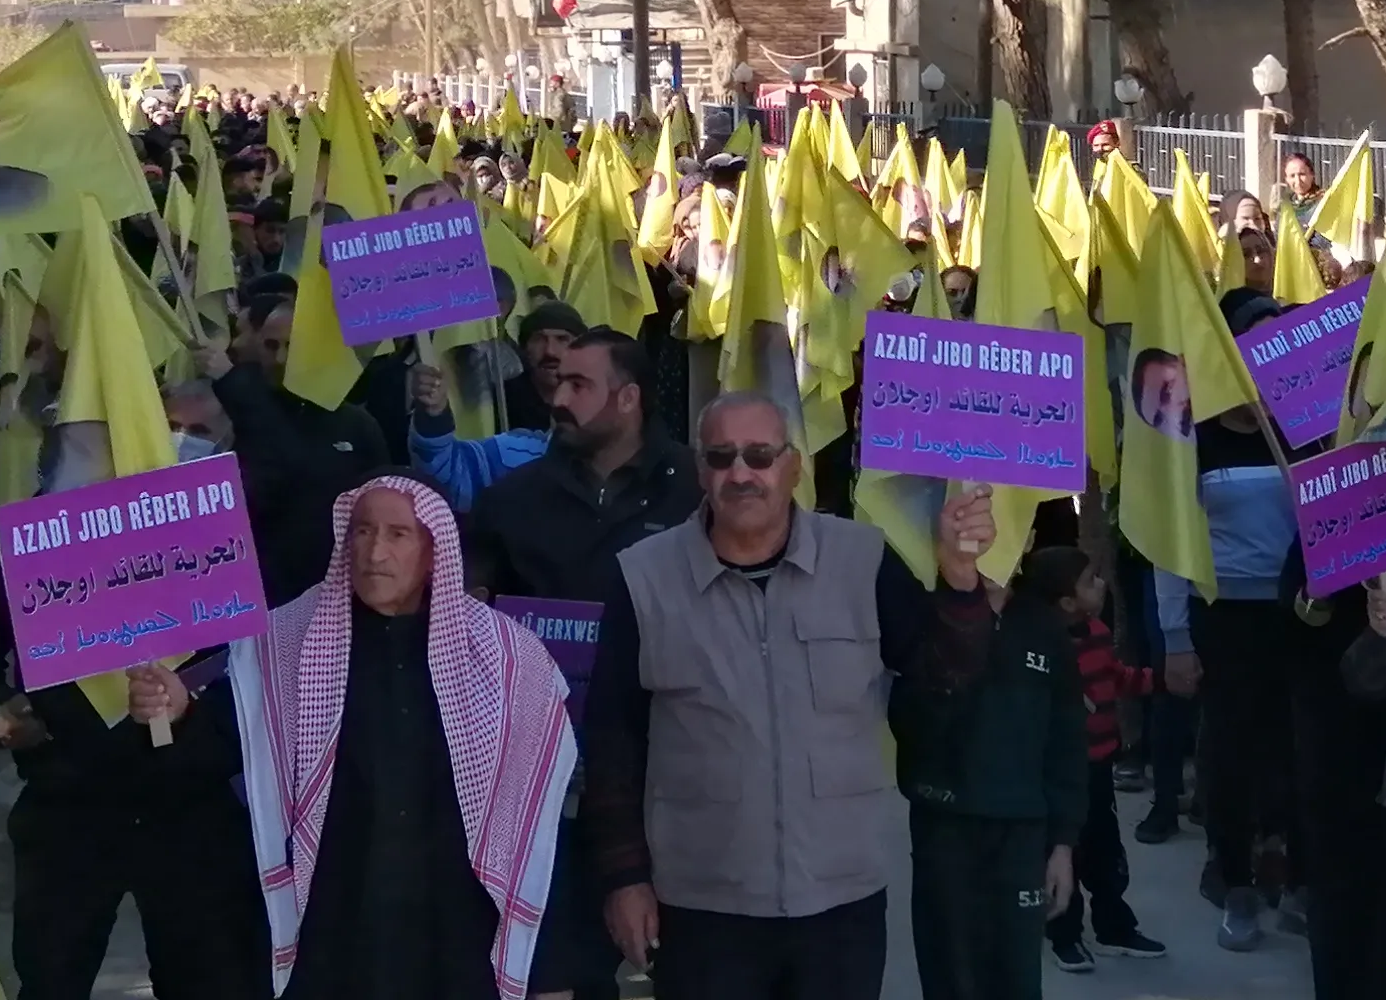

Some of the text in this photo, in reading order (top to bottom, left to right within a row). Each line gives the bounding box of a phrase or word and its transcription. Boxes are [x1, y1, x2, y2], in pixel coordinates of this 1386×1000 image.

[331, 216, 473, 262] AZADÎ JIBO RÊBER APO
[873, 332, 1073, 380] AZADÎ JIBO RÊBER APO
[1250, 301, 1362, 367] AZADÎ JIBO RÊBER
[872, 380, 1076, 427] الحرية للقائد اوجلان
[1299, 466, 1337, 506] AZADÎ
[1340, 459, 1370, 489] JIBO
[12, 480, 235, 556] AZADÎ JIBO RÊBER APO
[21, 533, 247, 616] الحرية للقائد اوجلان
